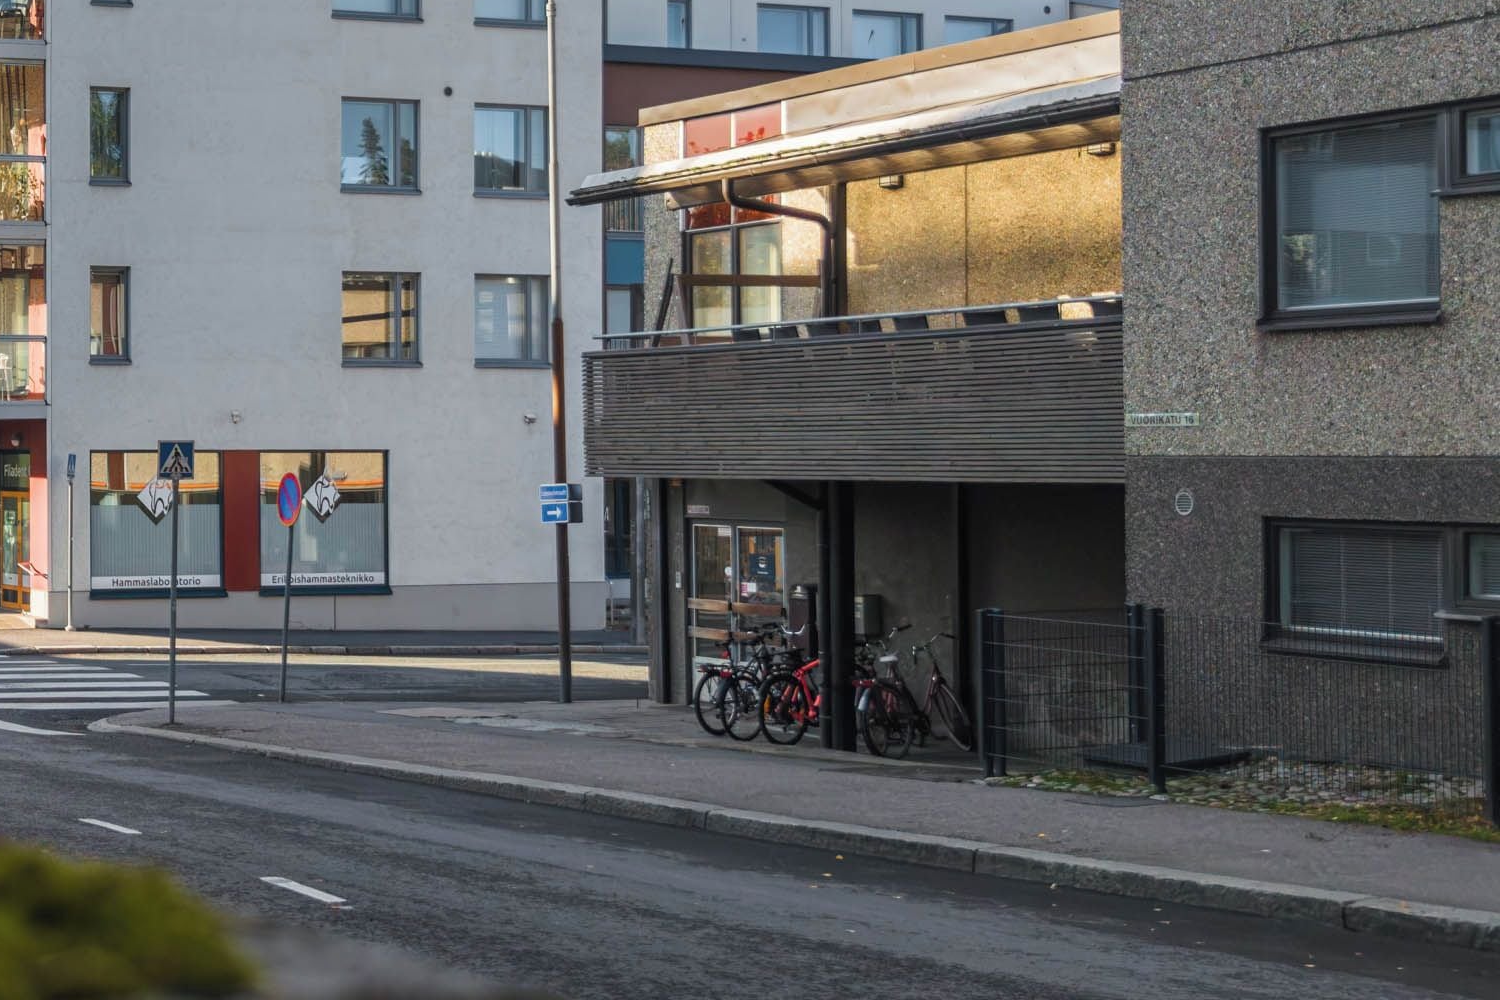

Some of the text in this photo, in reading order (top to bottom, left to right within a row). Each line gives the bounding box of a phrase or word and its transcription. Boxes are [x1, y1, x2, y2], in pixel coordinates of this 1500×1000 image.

[1131, 415, 1194, 425] VUORIKATU 16
[111, 576, 201, 587] Hammaslaboatorio
